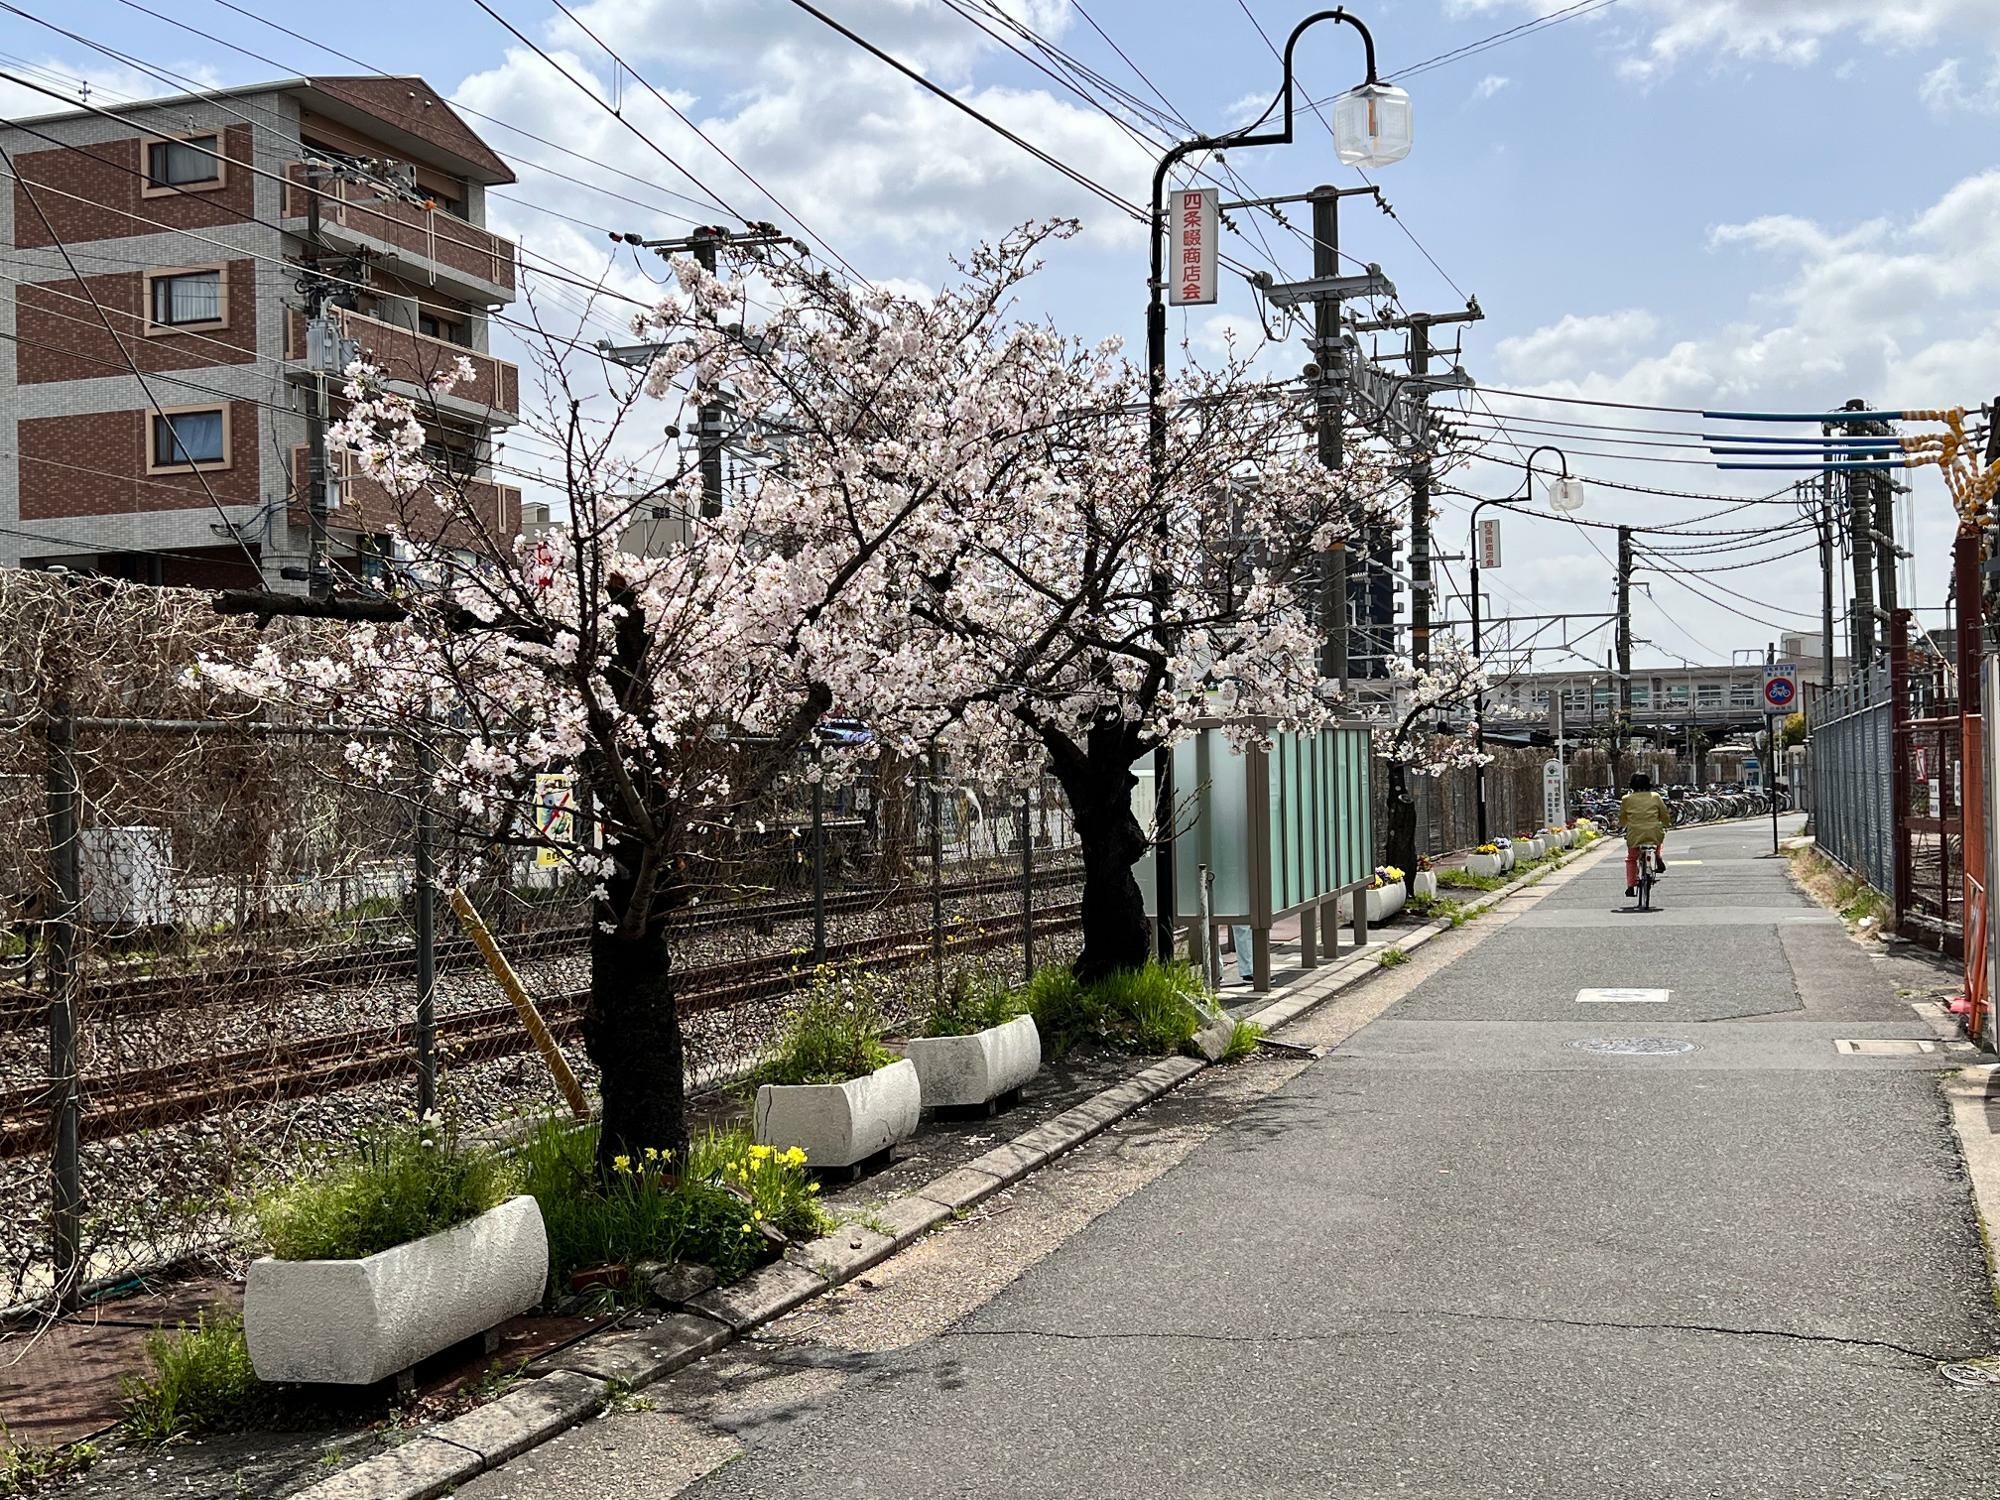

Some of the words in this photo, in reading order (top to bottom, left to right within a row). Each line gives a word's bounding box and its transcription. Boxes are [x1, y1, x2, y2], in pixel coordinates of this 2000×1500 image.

[1182, 193, 1202, 300] 四条畷商店会
